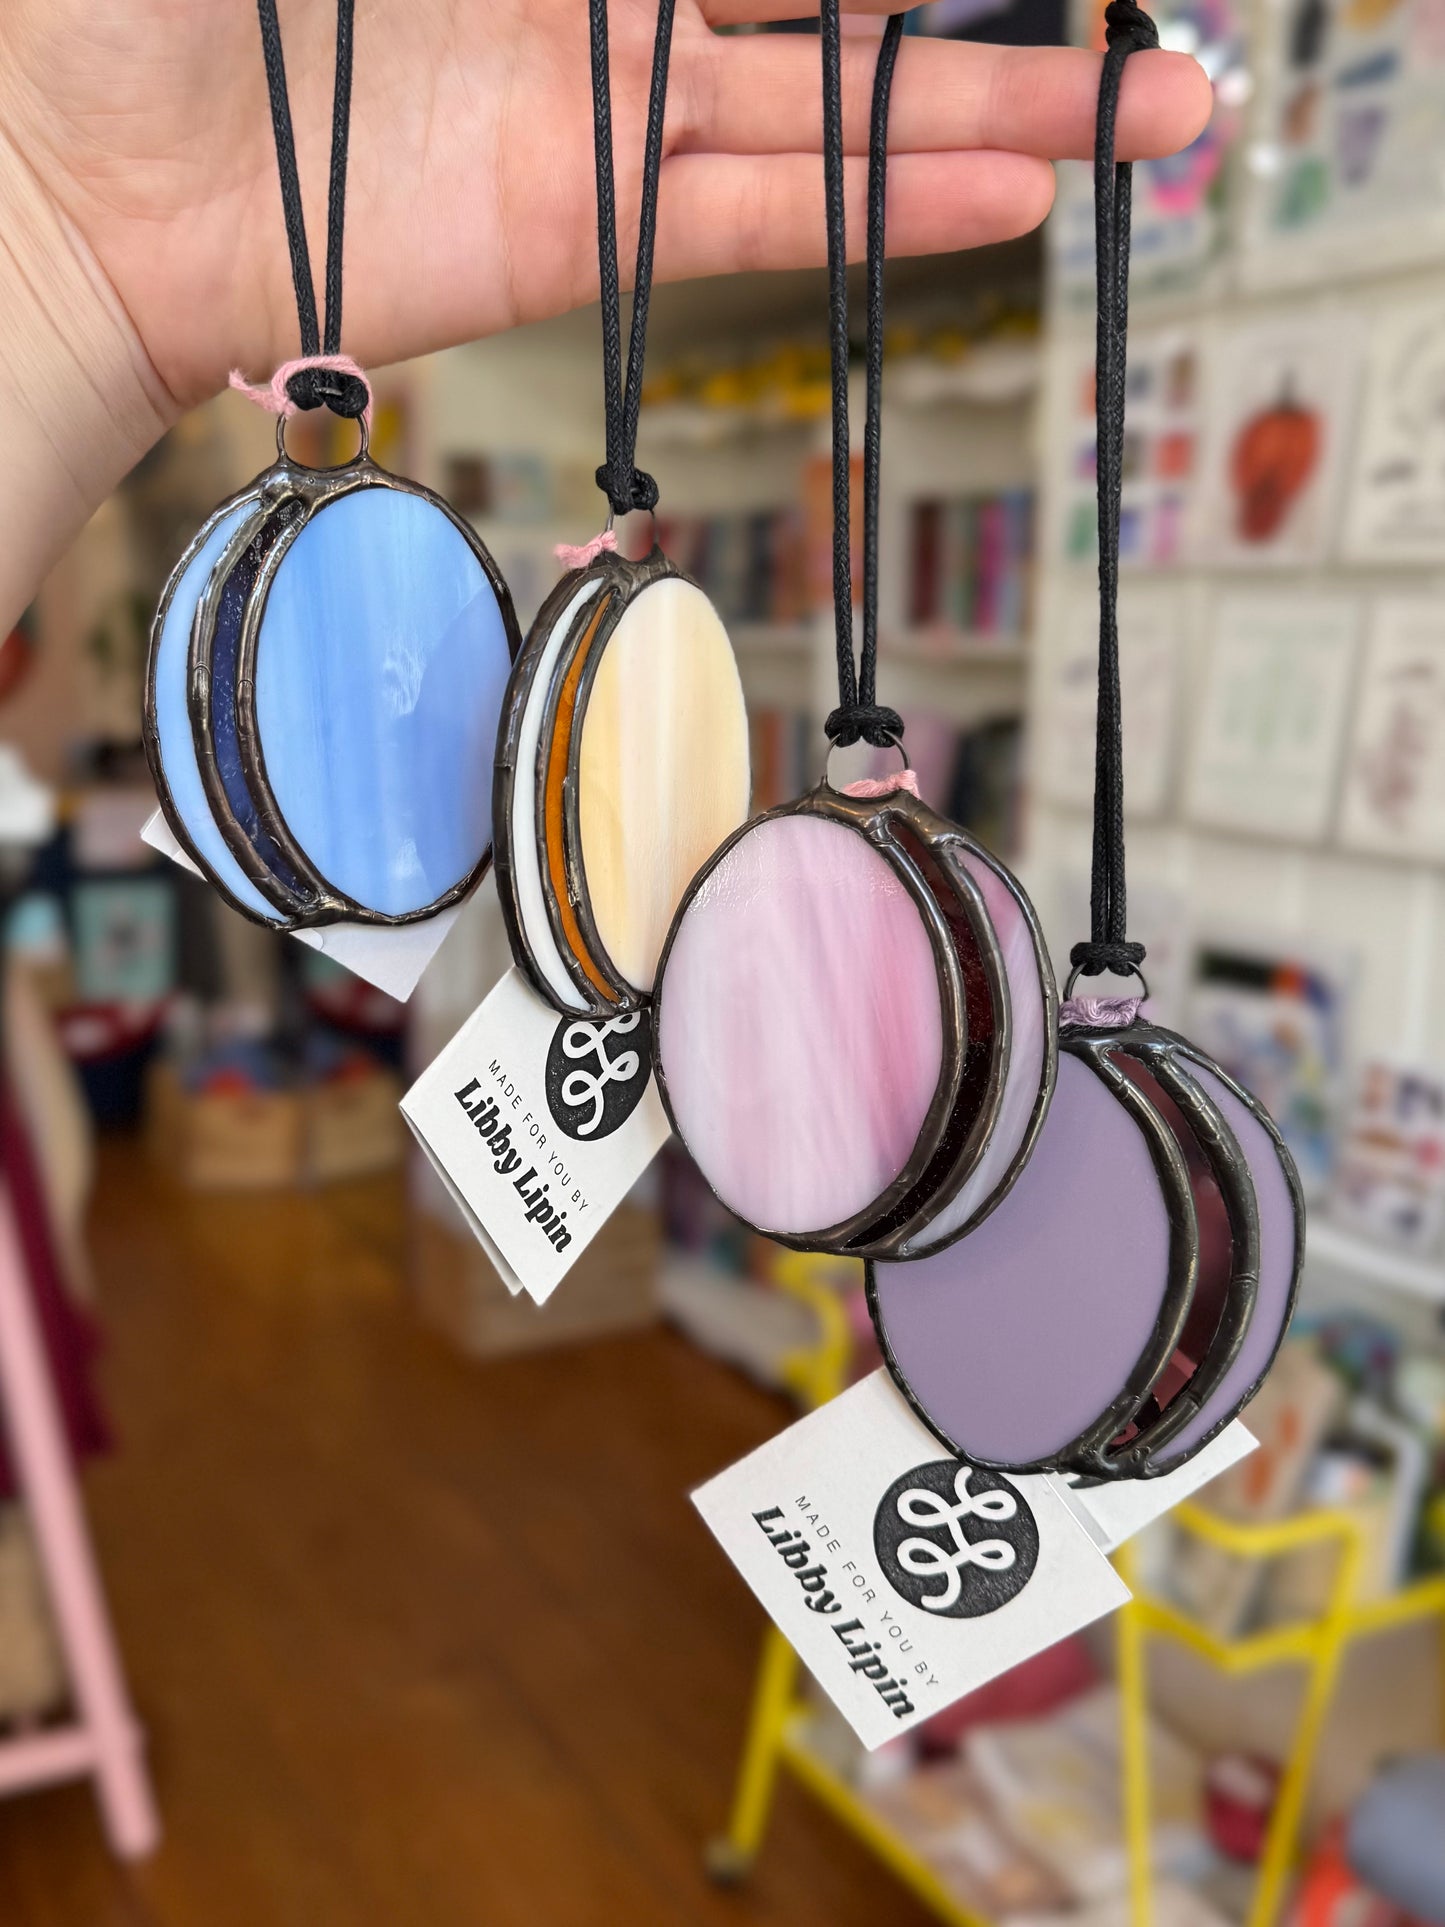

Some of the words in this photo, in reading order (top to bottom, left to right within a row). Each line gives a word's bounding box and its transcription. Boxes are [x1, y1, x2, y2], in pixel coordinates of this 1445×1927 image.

[453, 1077, 523, 1175] Libby
[512, 1165, 573, 1254] Lipin
[488, 1059, 523, 1110] MADE
[522, 1112, 547, 1149] FOR
[548, 1151, 572, 1187] YOU
[571, 1189, 589, 1212] BY
[751, 1505, 842, 1615] Libby
[831, 1617, 915, 1720] Lipin
[795, 1495, 841, 1553] MADE
[842, 1561, 876, 1603] FOR
[880, 1610, 913, 1653] YOU
[914, 1660, 939, 1688] BY
